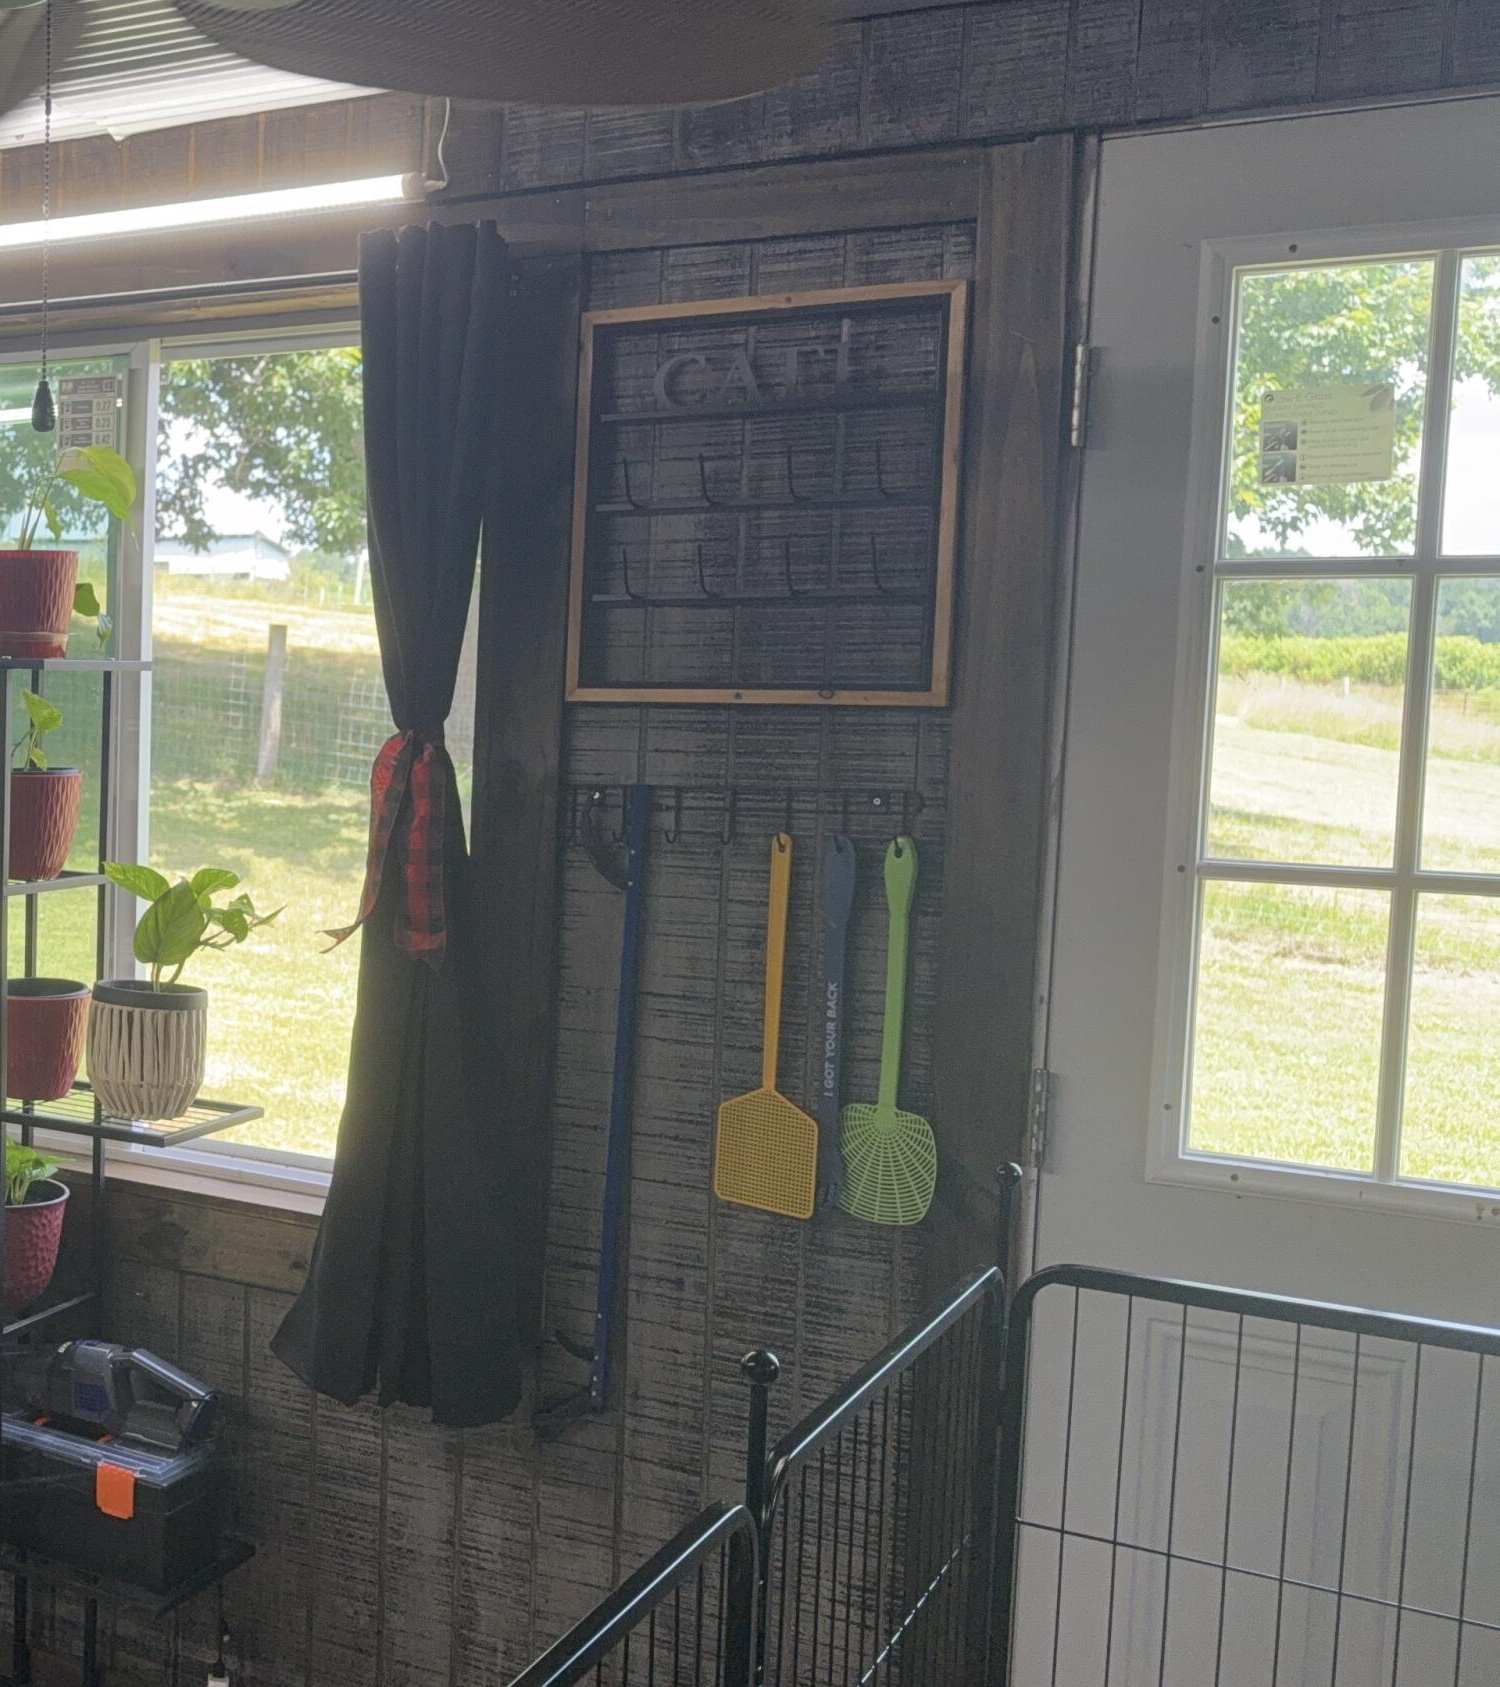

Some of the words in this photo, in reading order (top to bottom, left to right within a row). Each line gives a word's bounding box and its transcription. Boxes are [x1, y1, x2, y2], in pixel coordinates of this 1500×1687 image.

[826, 981, 838, 1018] BACK
[825, 1022, 836, 1058] YOUR
[824, 1061, 835, 1089] GOT
